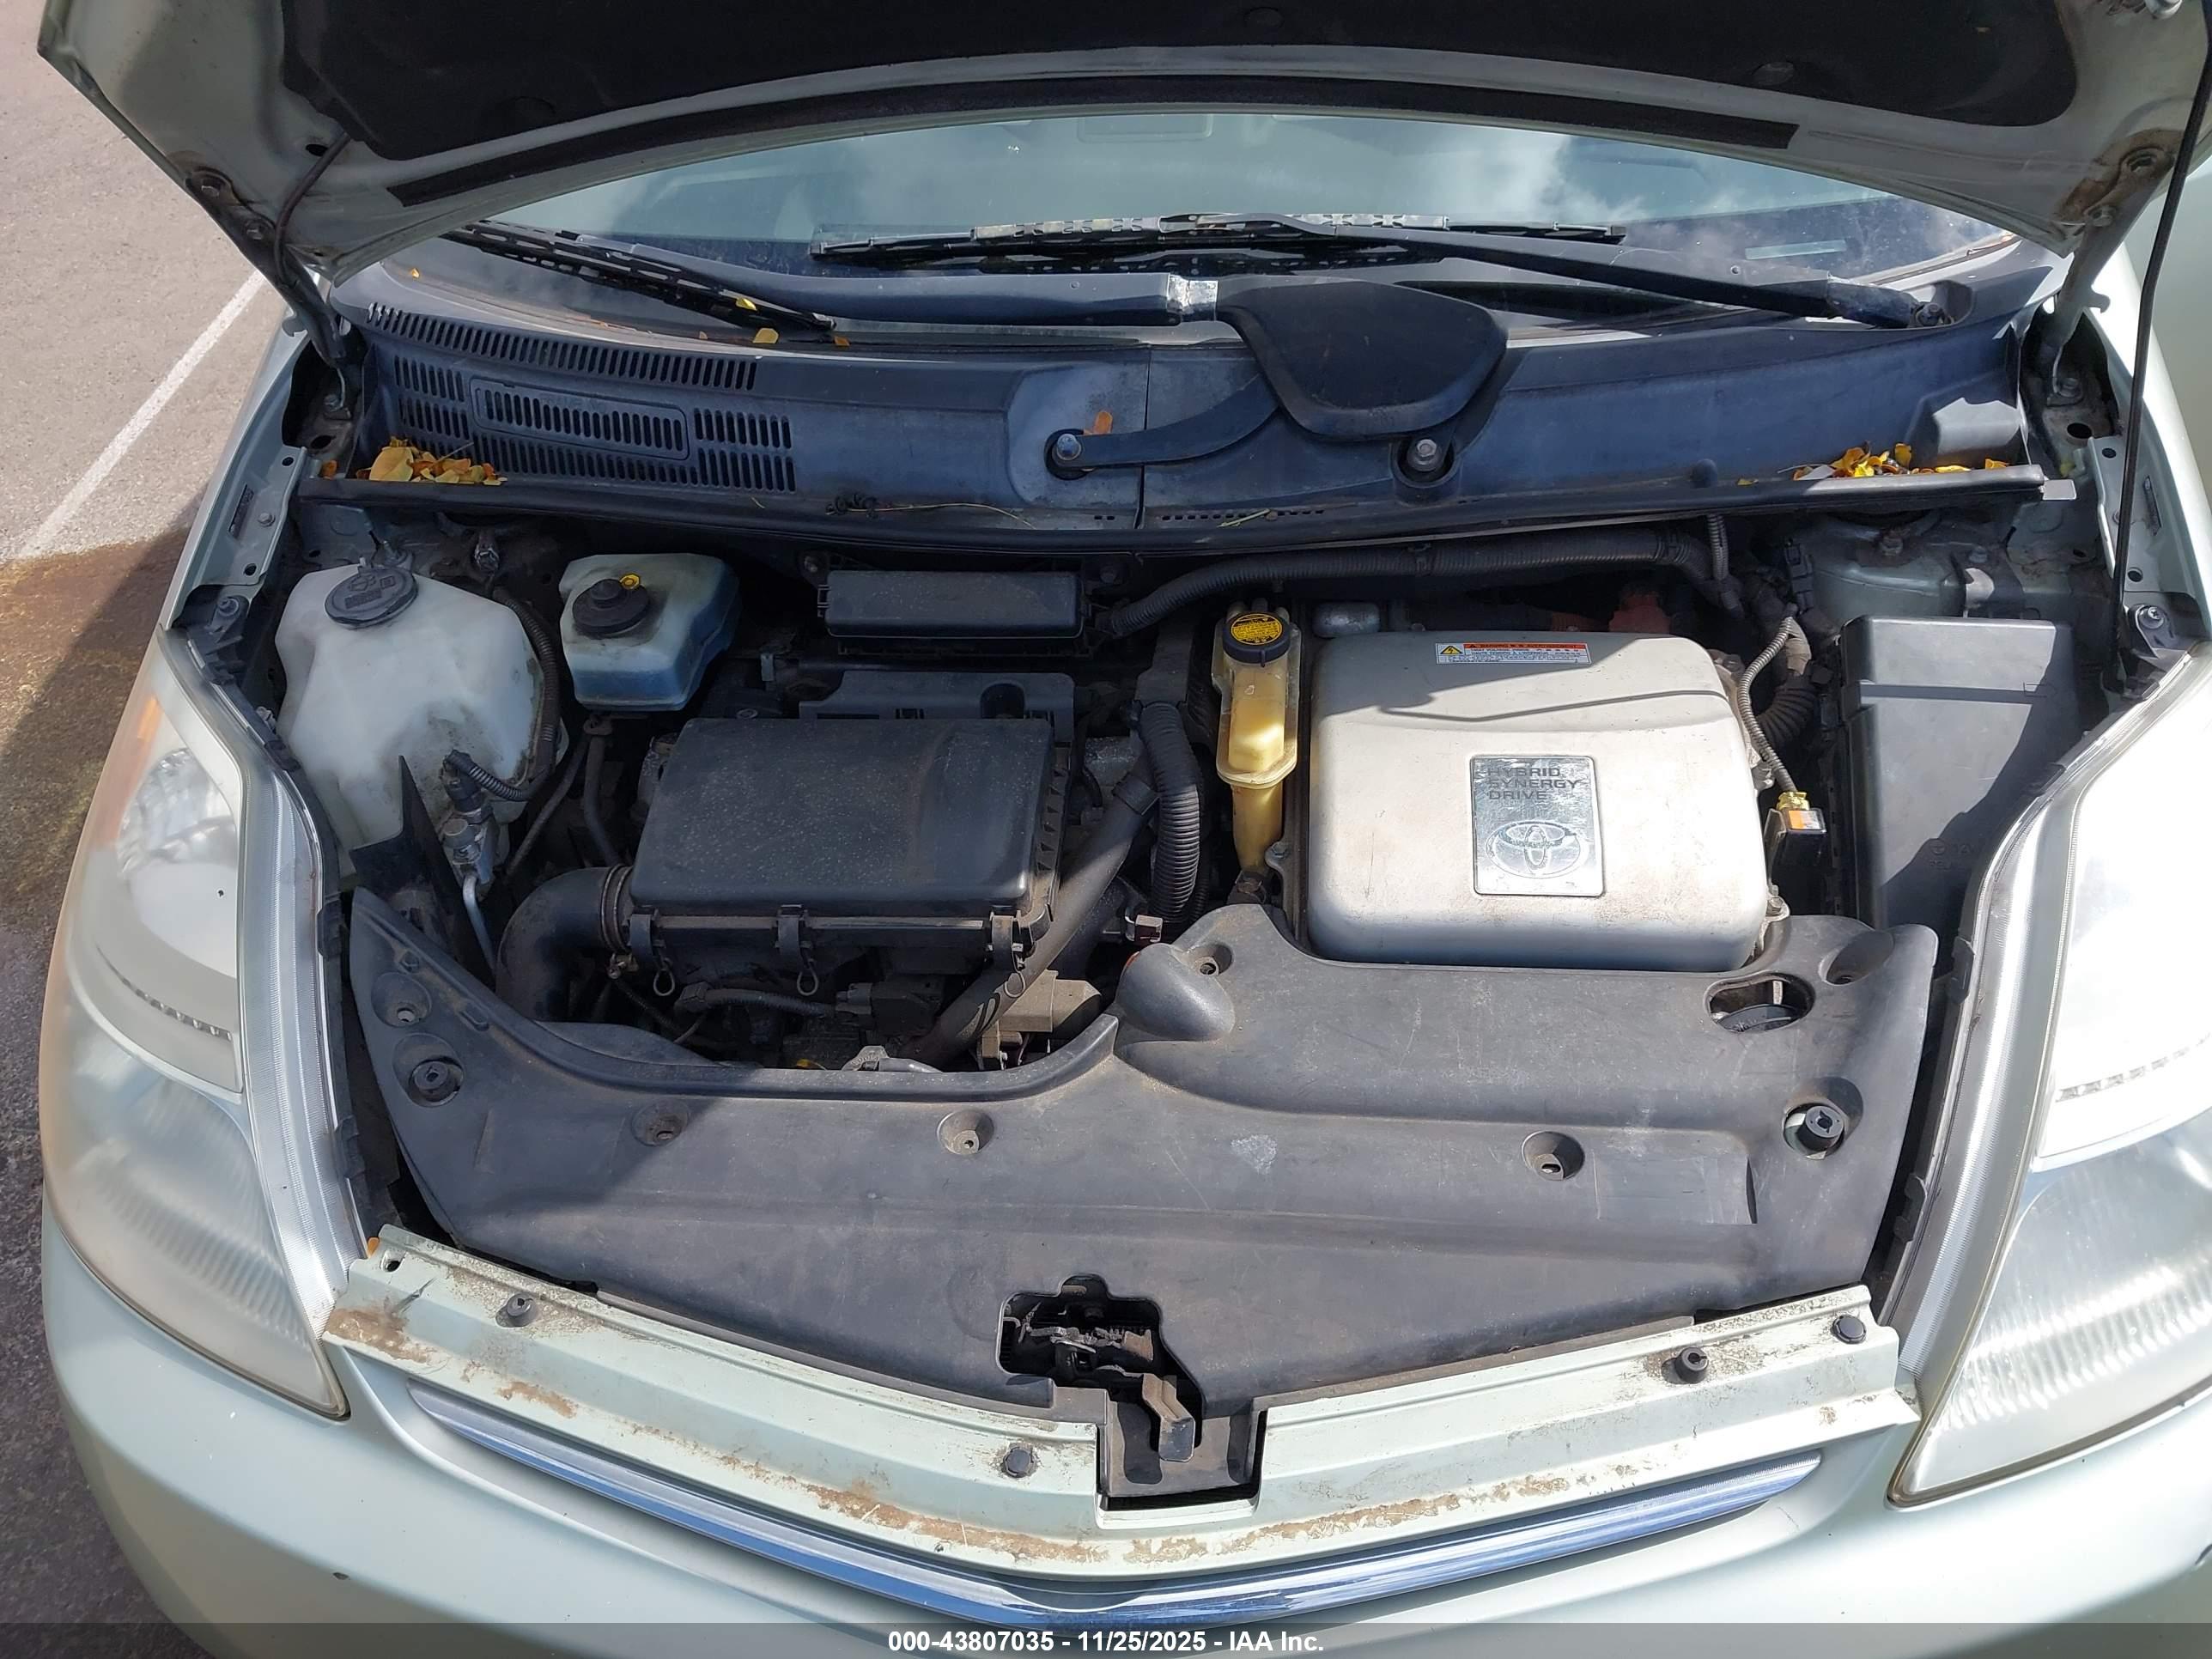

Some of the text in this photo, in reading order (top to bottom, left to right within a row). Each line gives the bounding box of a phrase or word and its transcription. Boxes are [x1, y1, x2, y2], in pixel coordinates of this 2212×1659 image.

[1488, 768, 1560, 776] HYBRID
[1489, 779, 1582, 788] SYNERGY
[1489, 791, 1547, 799] DRIVE
